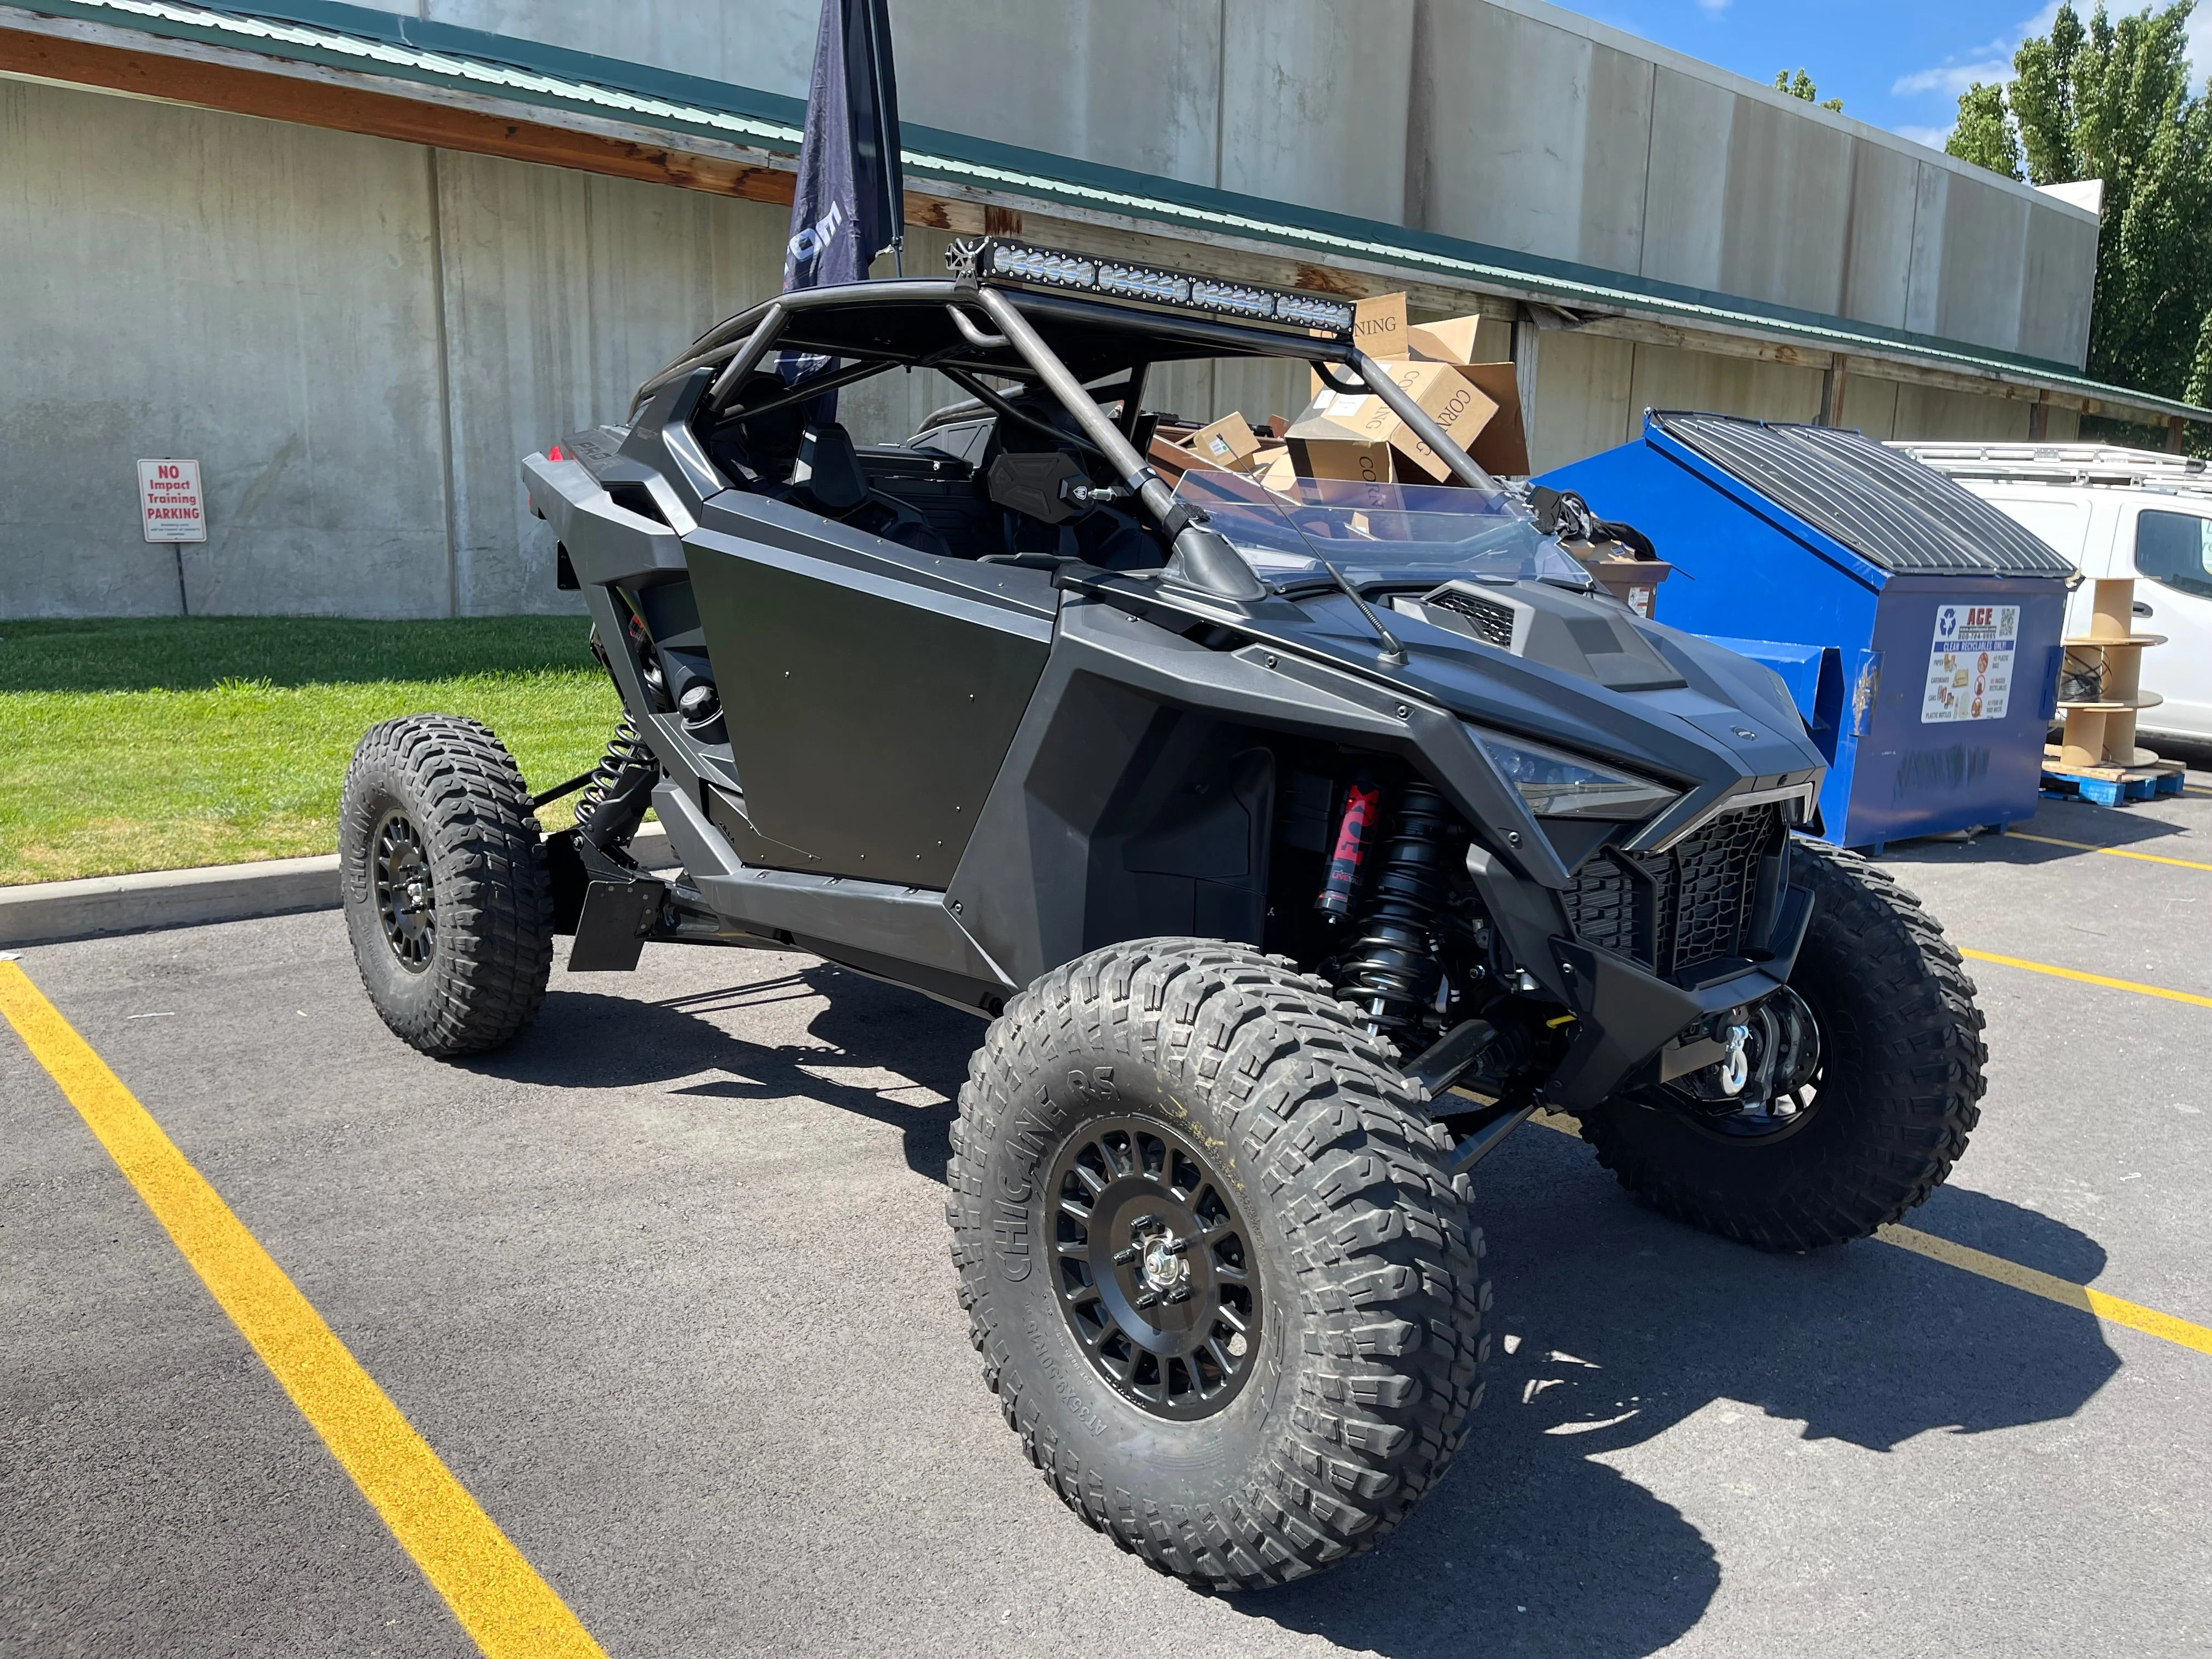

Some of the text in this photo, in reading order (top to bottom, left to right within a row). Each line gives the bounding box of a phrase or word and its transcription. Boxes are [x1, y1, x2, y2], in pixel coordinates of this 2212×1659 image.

[573, 441, 613, 461] PRO
[158, 465, 179, 479] NO
[150, 480, 190, 492] Impact
[148, 493, 196, 505] Training
[147, 508, 200, 519] PARKING
[1967, 608, 1993, 625] ACE
[1943, 641, 2006, 652] CLEAN RECYCLABLES ONLY!
[993, 1066, 1120, 1283] CHICANE RS
